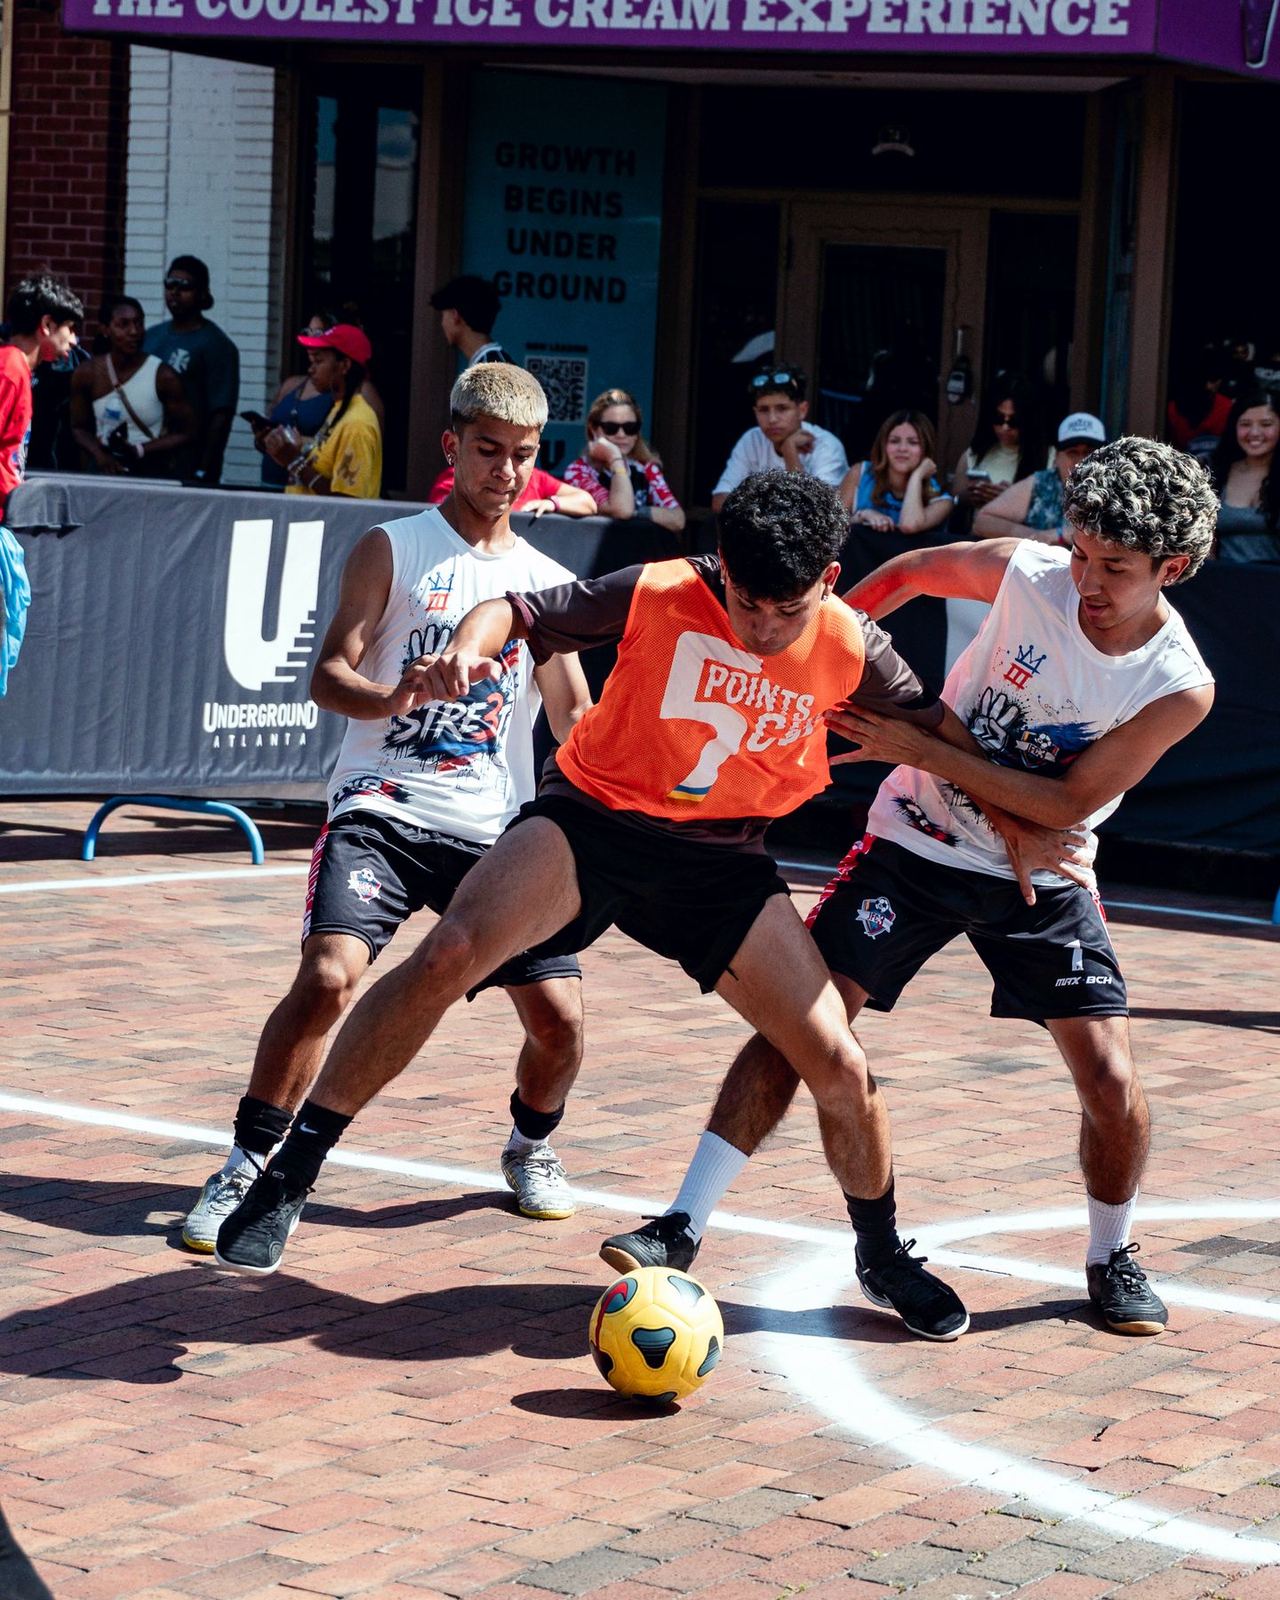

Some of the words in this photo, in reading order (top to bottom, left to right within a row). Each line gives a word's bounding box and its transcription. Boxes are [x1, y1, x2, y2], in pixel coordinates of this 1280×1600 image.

[433, 0, 521, 26] ICE
[534, 0, 730, 31] CREAM
[742, 0, 1129, 35] EXPERIENCE
[495, 141, 636, 176] GROWTH
[504, 184, 624, 219] BEGINS
[506, 228, 617, 261] UNDER
[494, 270, 627, 304] GROUND
[704, 663, 815, 722] POINTS
[203, 699, 319, 733] UNDERGROUND
[213, 732, 307, 748] ATLANTA
[1085, 975, 1113, 985] BCH
